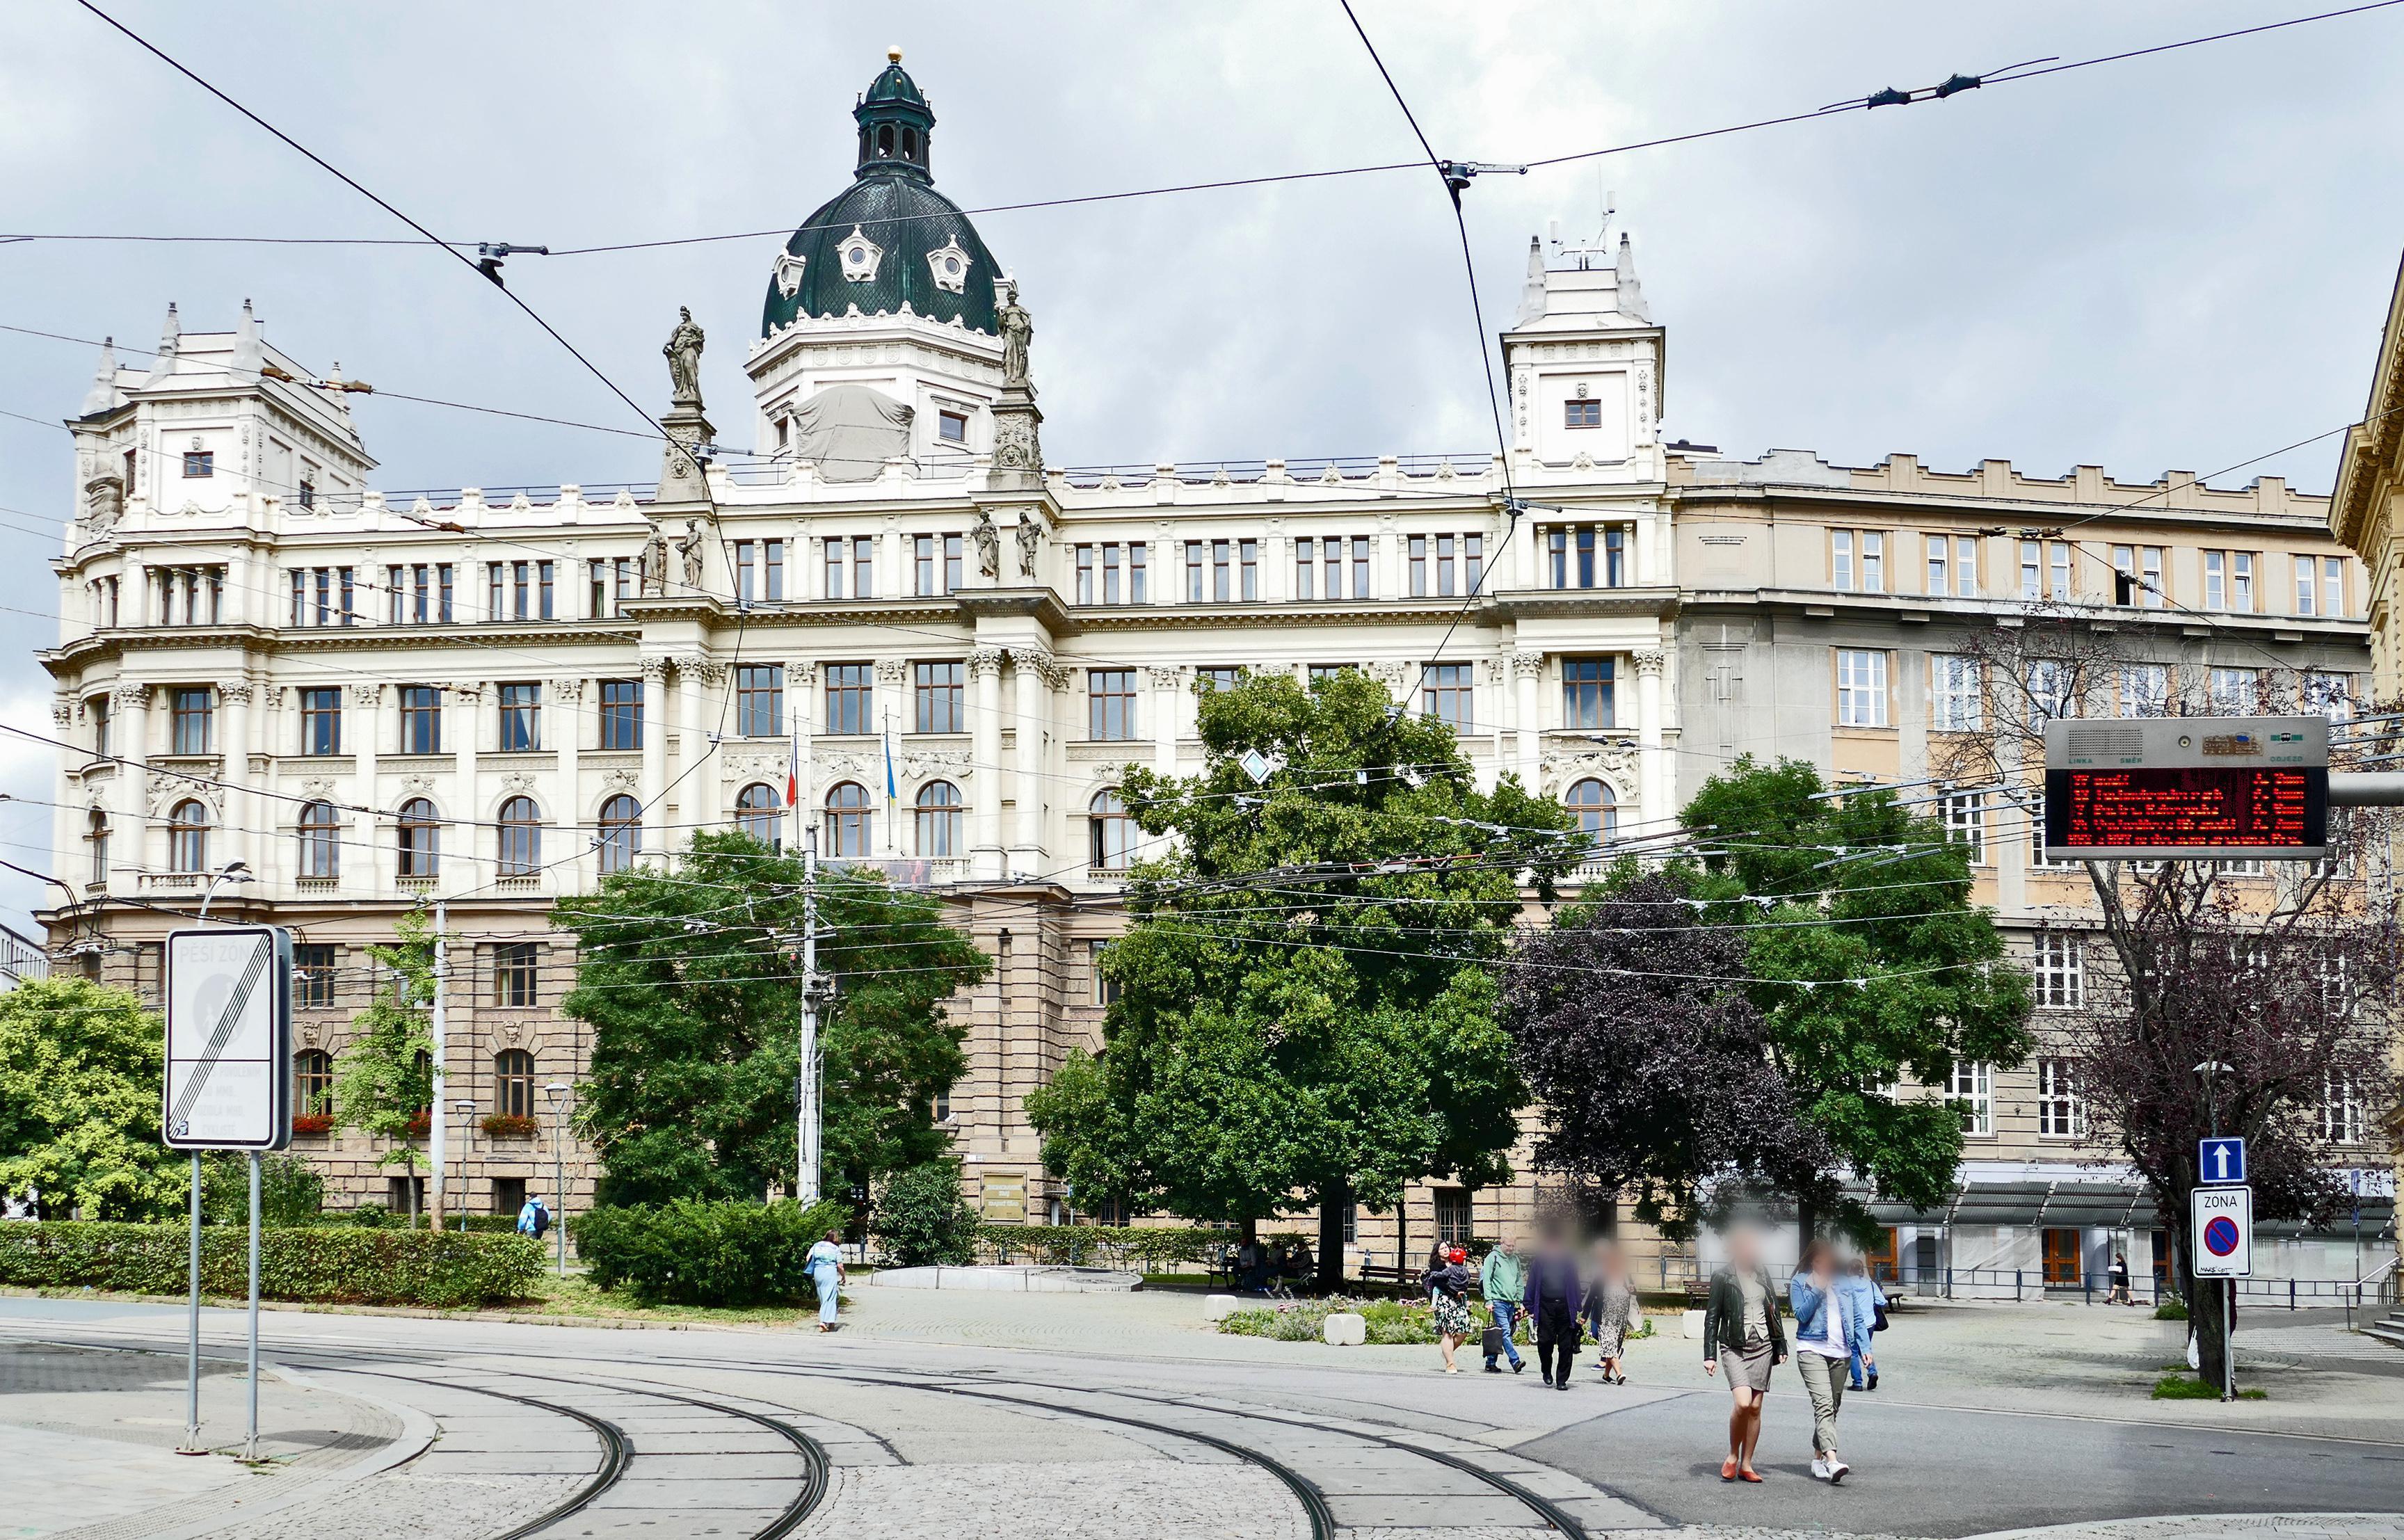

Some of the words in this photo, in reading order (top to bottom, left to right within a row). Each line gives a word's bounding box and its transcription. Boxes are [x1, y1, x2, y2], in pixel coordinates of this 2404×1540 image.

[180, 940, 215, 963] PĚŠÍ
[218, 940, 255, 963] ZÓN
[2204, 1193, 2238, 1208] ZÓNA
